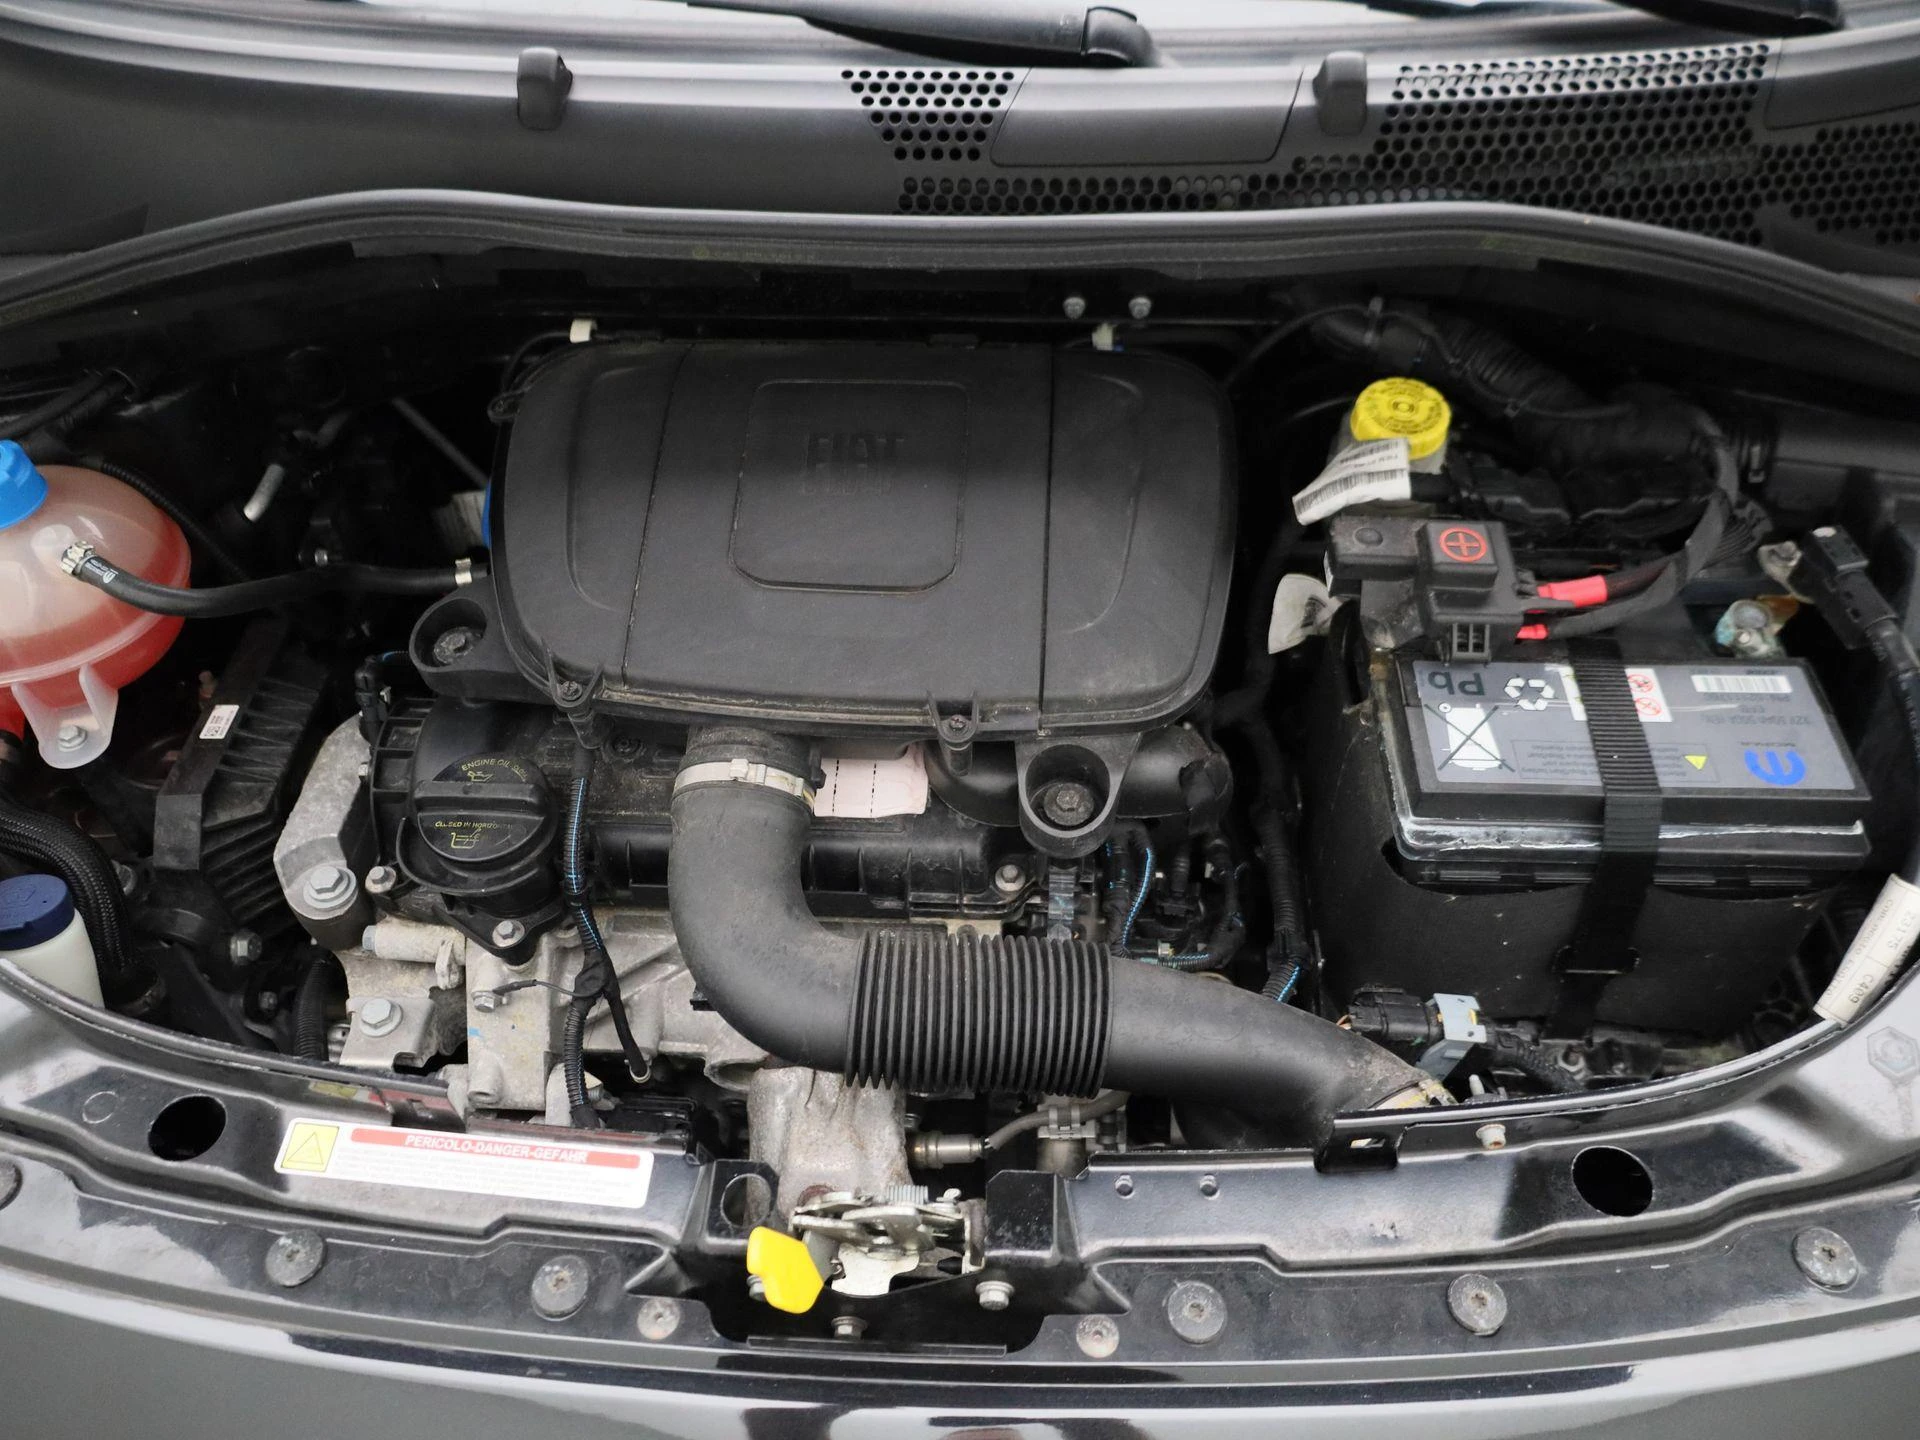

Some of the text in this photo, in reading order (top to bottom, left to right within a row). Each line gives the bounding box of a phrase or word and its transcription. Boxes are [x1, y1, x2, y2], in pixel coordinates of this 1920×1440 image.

[807, 431, 904, 468] FIAT
[1428, 671, 1485, 696] Pb
[461, 759, 511, 771] ENGINE OIL
[404, 1134, 589, 1163] PERICOLO-DANGER-GEFAHR
